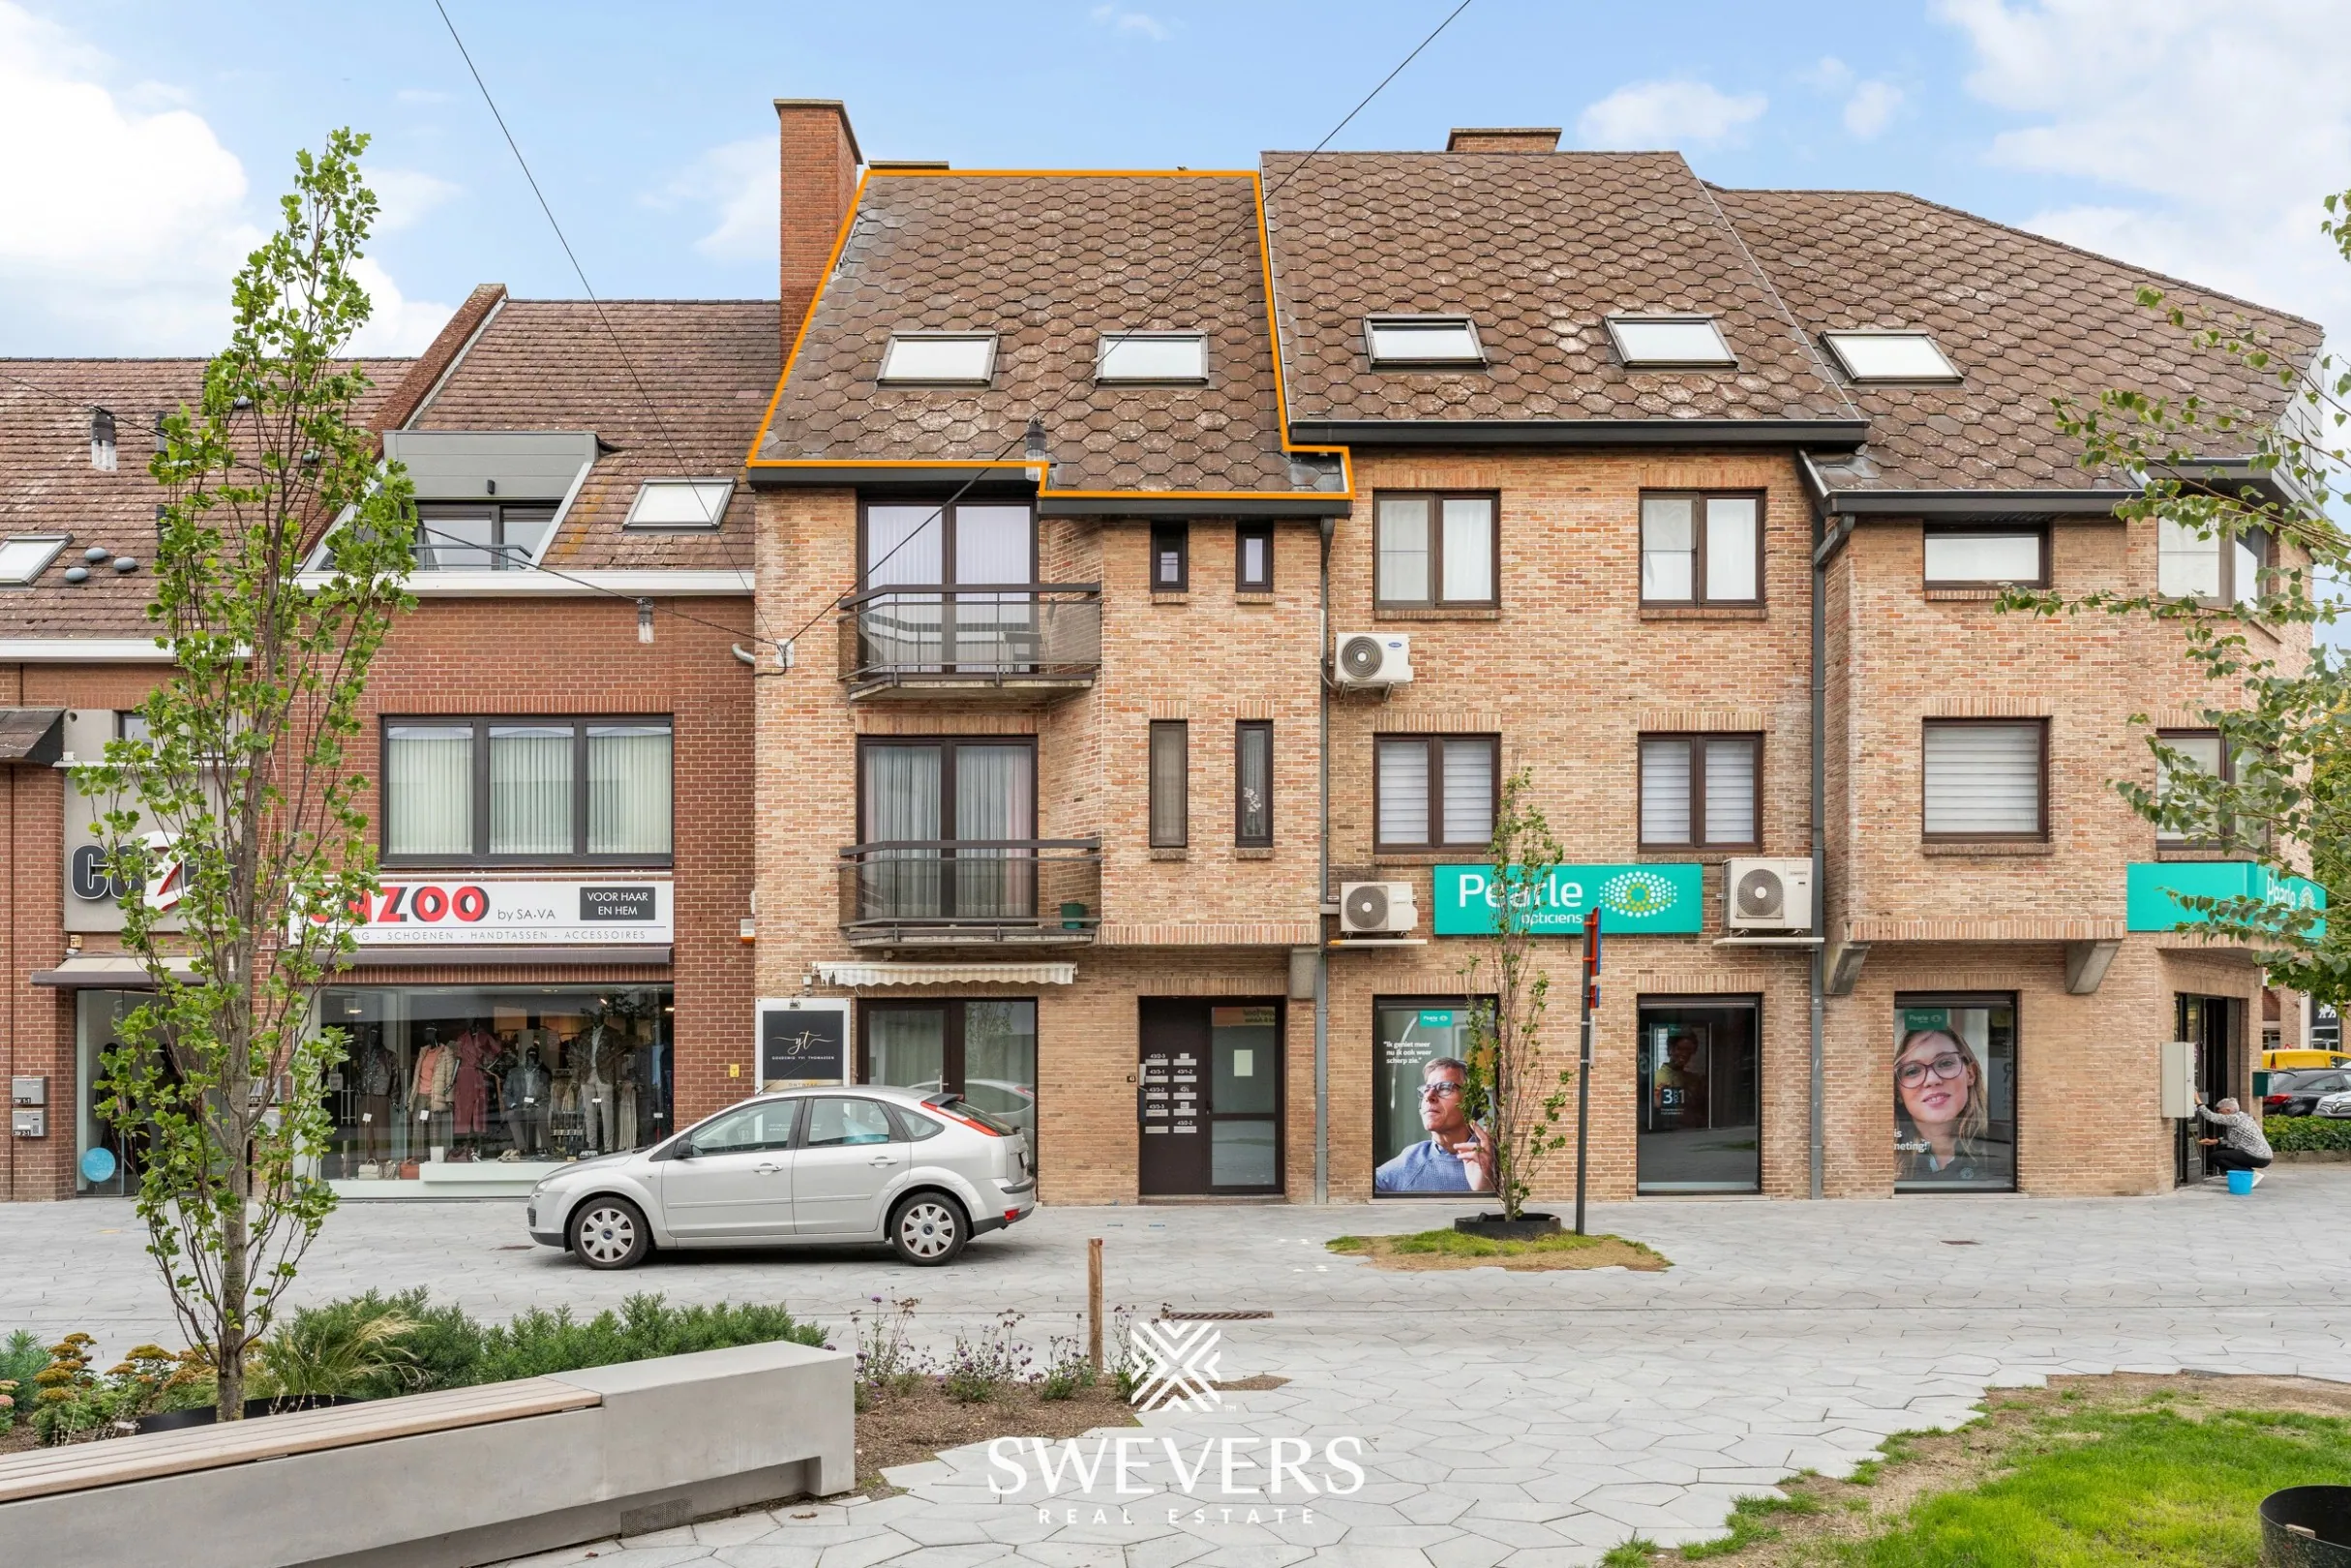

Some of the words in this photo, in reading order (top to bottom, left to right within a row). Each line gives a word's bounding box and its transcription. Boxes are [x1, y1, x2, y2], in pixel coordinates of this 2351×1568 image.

[1460, 874, 1583, 908] Pearle
[587, 892, 618, 902] VOOR
[621, 892, 648, 902] HAAR
[497, 909, 513, 921] by
[598, 906, 613, 916] EN
[616, 906, 638, 916] HEM
[1522, 912, 1582, 926] opticiens
[387, 931, 454, 941] SCHOENEN
[470, 931, 548, 940] HANDTASSEN
[564, 931, 646, 940] ACCESSOIRES
[1394, 1040, 1413, 1049] geniet
[1663, 1089, 1673, 1104] 3
[1679, 1089, 1685, 1104] 1
